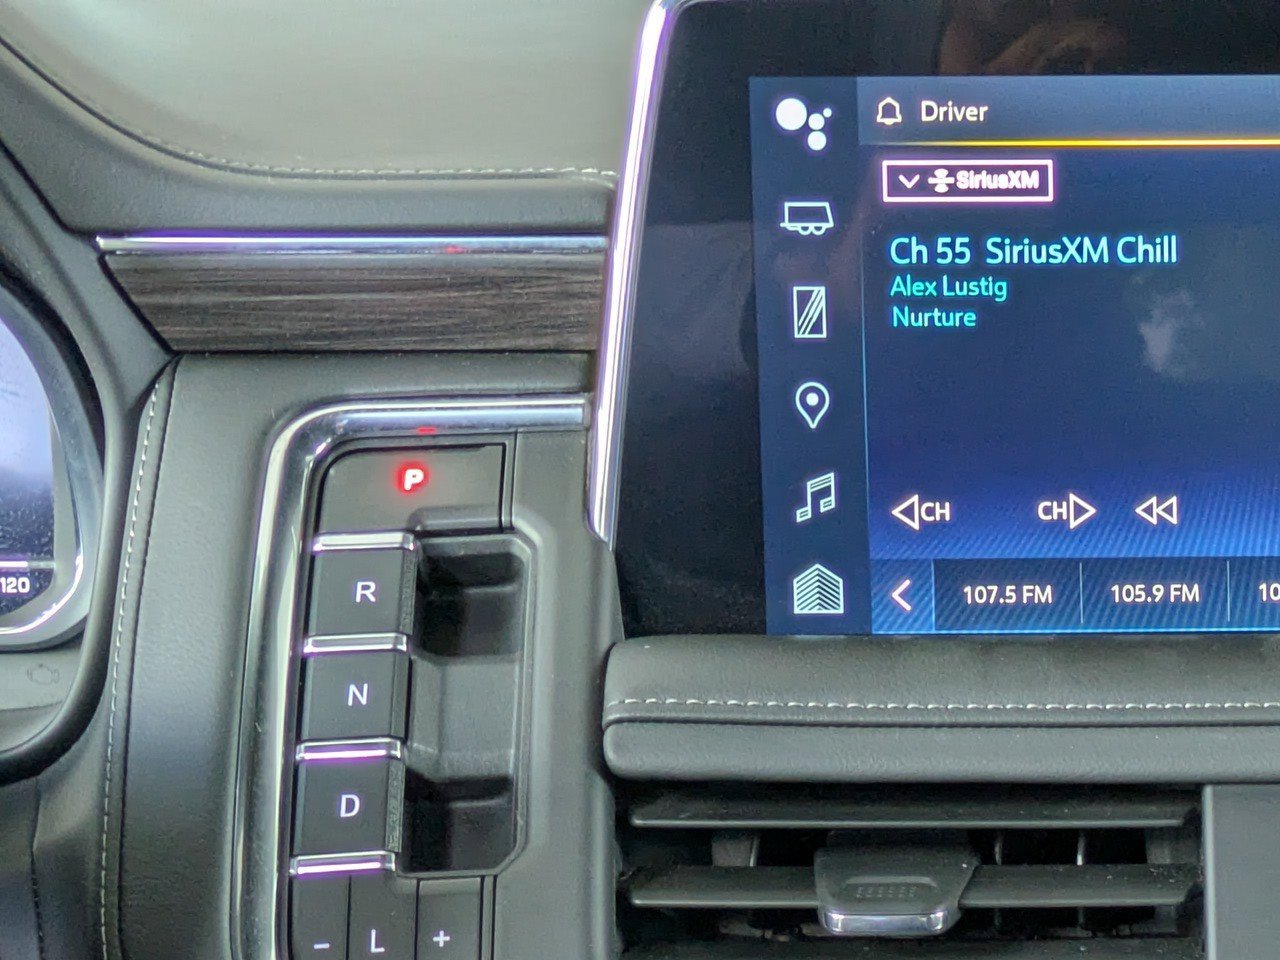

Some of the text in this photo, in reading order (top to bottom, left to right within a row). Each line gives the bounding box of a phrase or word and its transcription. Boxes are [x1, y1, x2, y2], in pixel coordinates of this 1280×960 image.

[921, 101, 988, 123] Driver
[956, 170, 1040, 190] SiriusXM
[890, 235, 1178, 265] Ch 55 SiriusXM Chill
[891, 274, 1008, 301] Alex Lustig
[893, 307, 977, 327] Nurture
[403, 469, 424, 491] P
[921, 502, 950, 521] CH
[1037, 501, 1067, 520] CH
[0, 577, 30, 593] 120
[356, 582, 376, 602] R
[963, 585, 1053, 605] 107.5 FM
[1111, 583, 1200, 603] 105.9 FM
[348, 684, 369, 705] N
[340, 795, 360, 817] D
[371, 930, 385, 953] L
